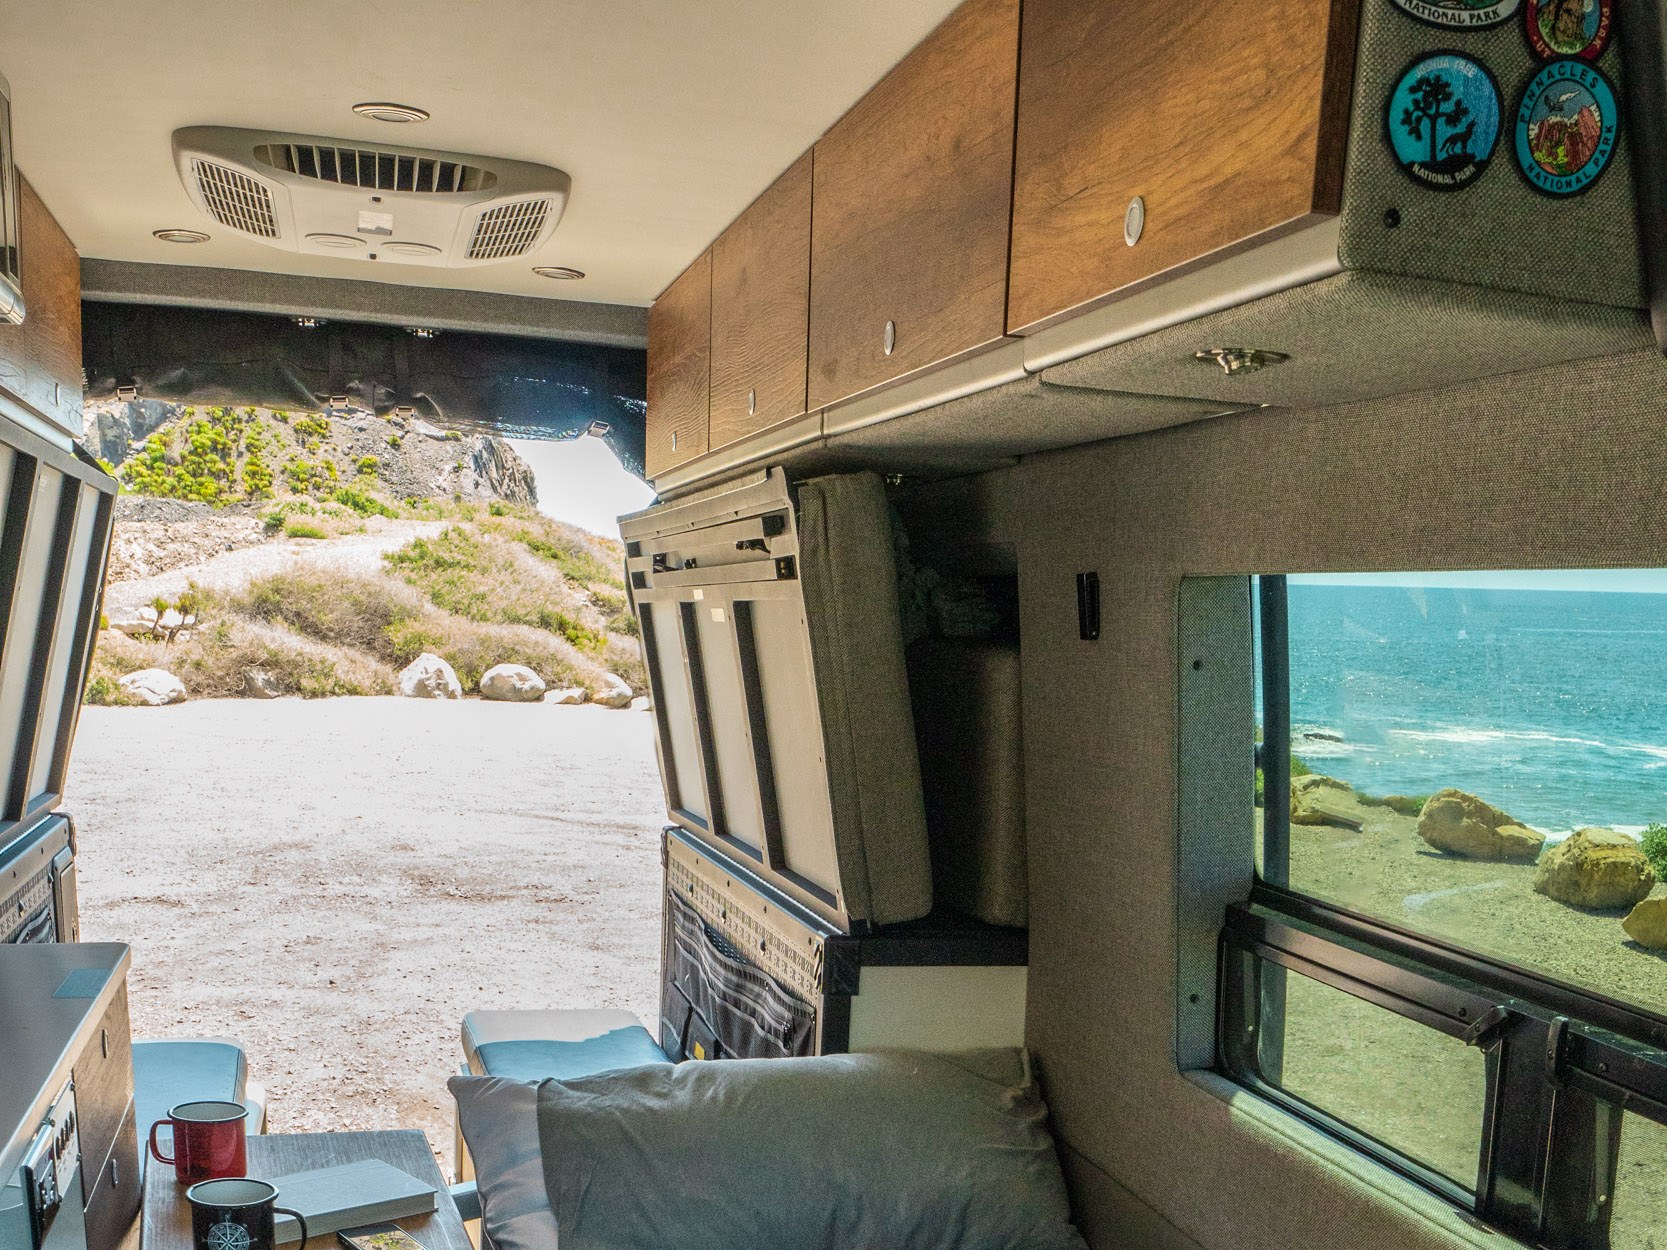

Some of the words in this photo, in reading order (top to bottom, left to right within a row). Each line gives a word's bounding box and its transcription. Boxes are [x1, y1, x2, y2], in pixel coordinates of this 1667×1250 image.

[1403, 0, 1466, 23] NATIONAL
[1469, 7, 1500, 24] PARK
[1592, 7, 1610, 48] PARK
[1416, 57, 1450, 78] JOSHUA
[1453, 59, 1478, 78] TREE
[1520, 64, 1598, 124] PINNACLES
[1527, 162, 1590, 189] NATIONAL
[1593, 124, 1614, 167] PARK
[1412, 162, 1454, 184] NATIONAL
[1455, 162, 1477, 183] PARK
